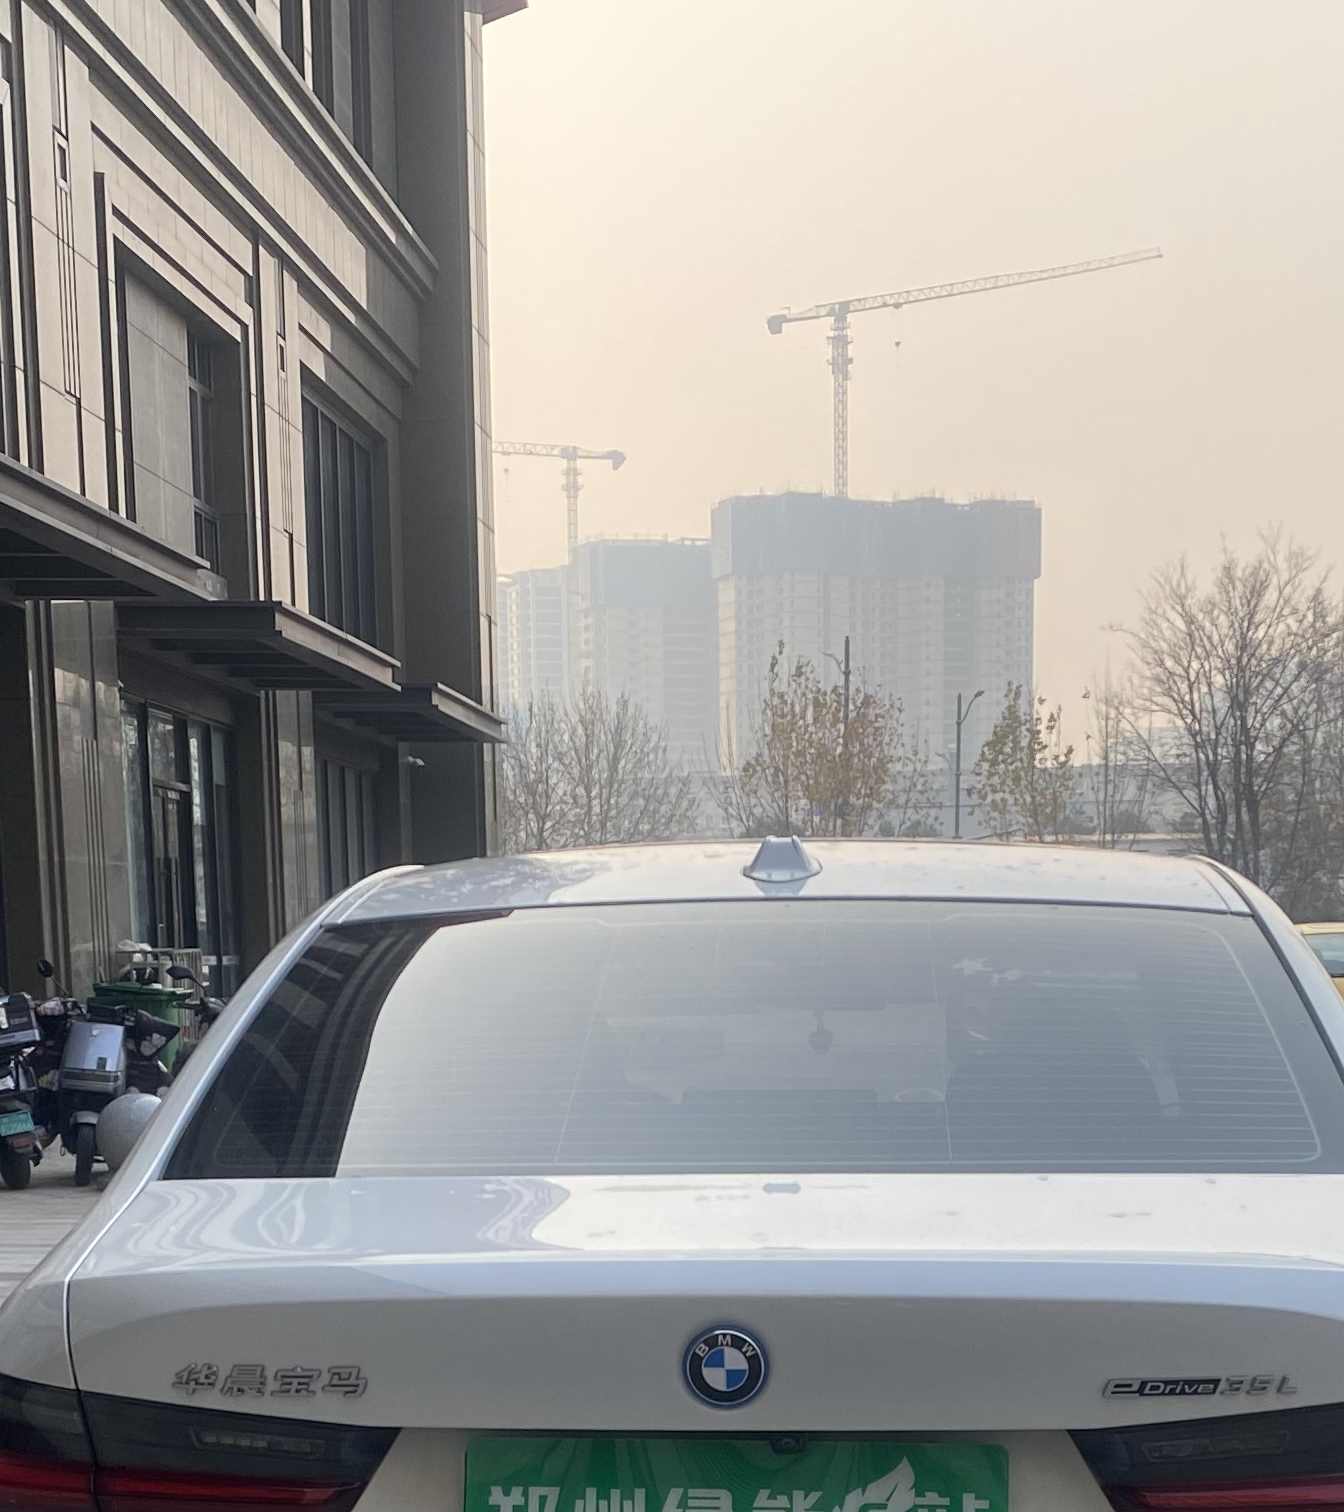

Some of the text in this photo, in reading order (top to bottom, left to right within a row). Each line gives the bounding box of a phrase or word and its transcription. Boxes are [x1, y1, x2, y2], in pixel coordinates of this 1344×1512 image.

[695, 1335, 756, 1357] BMW
[172, 1362, 368, 1398] 华晨宝马
